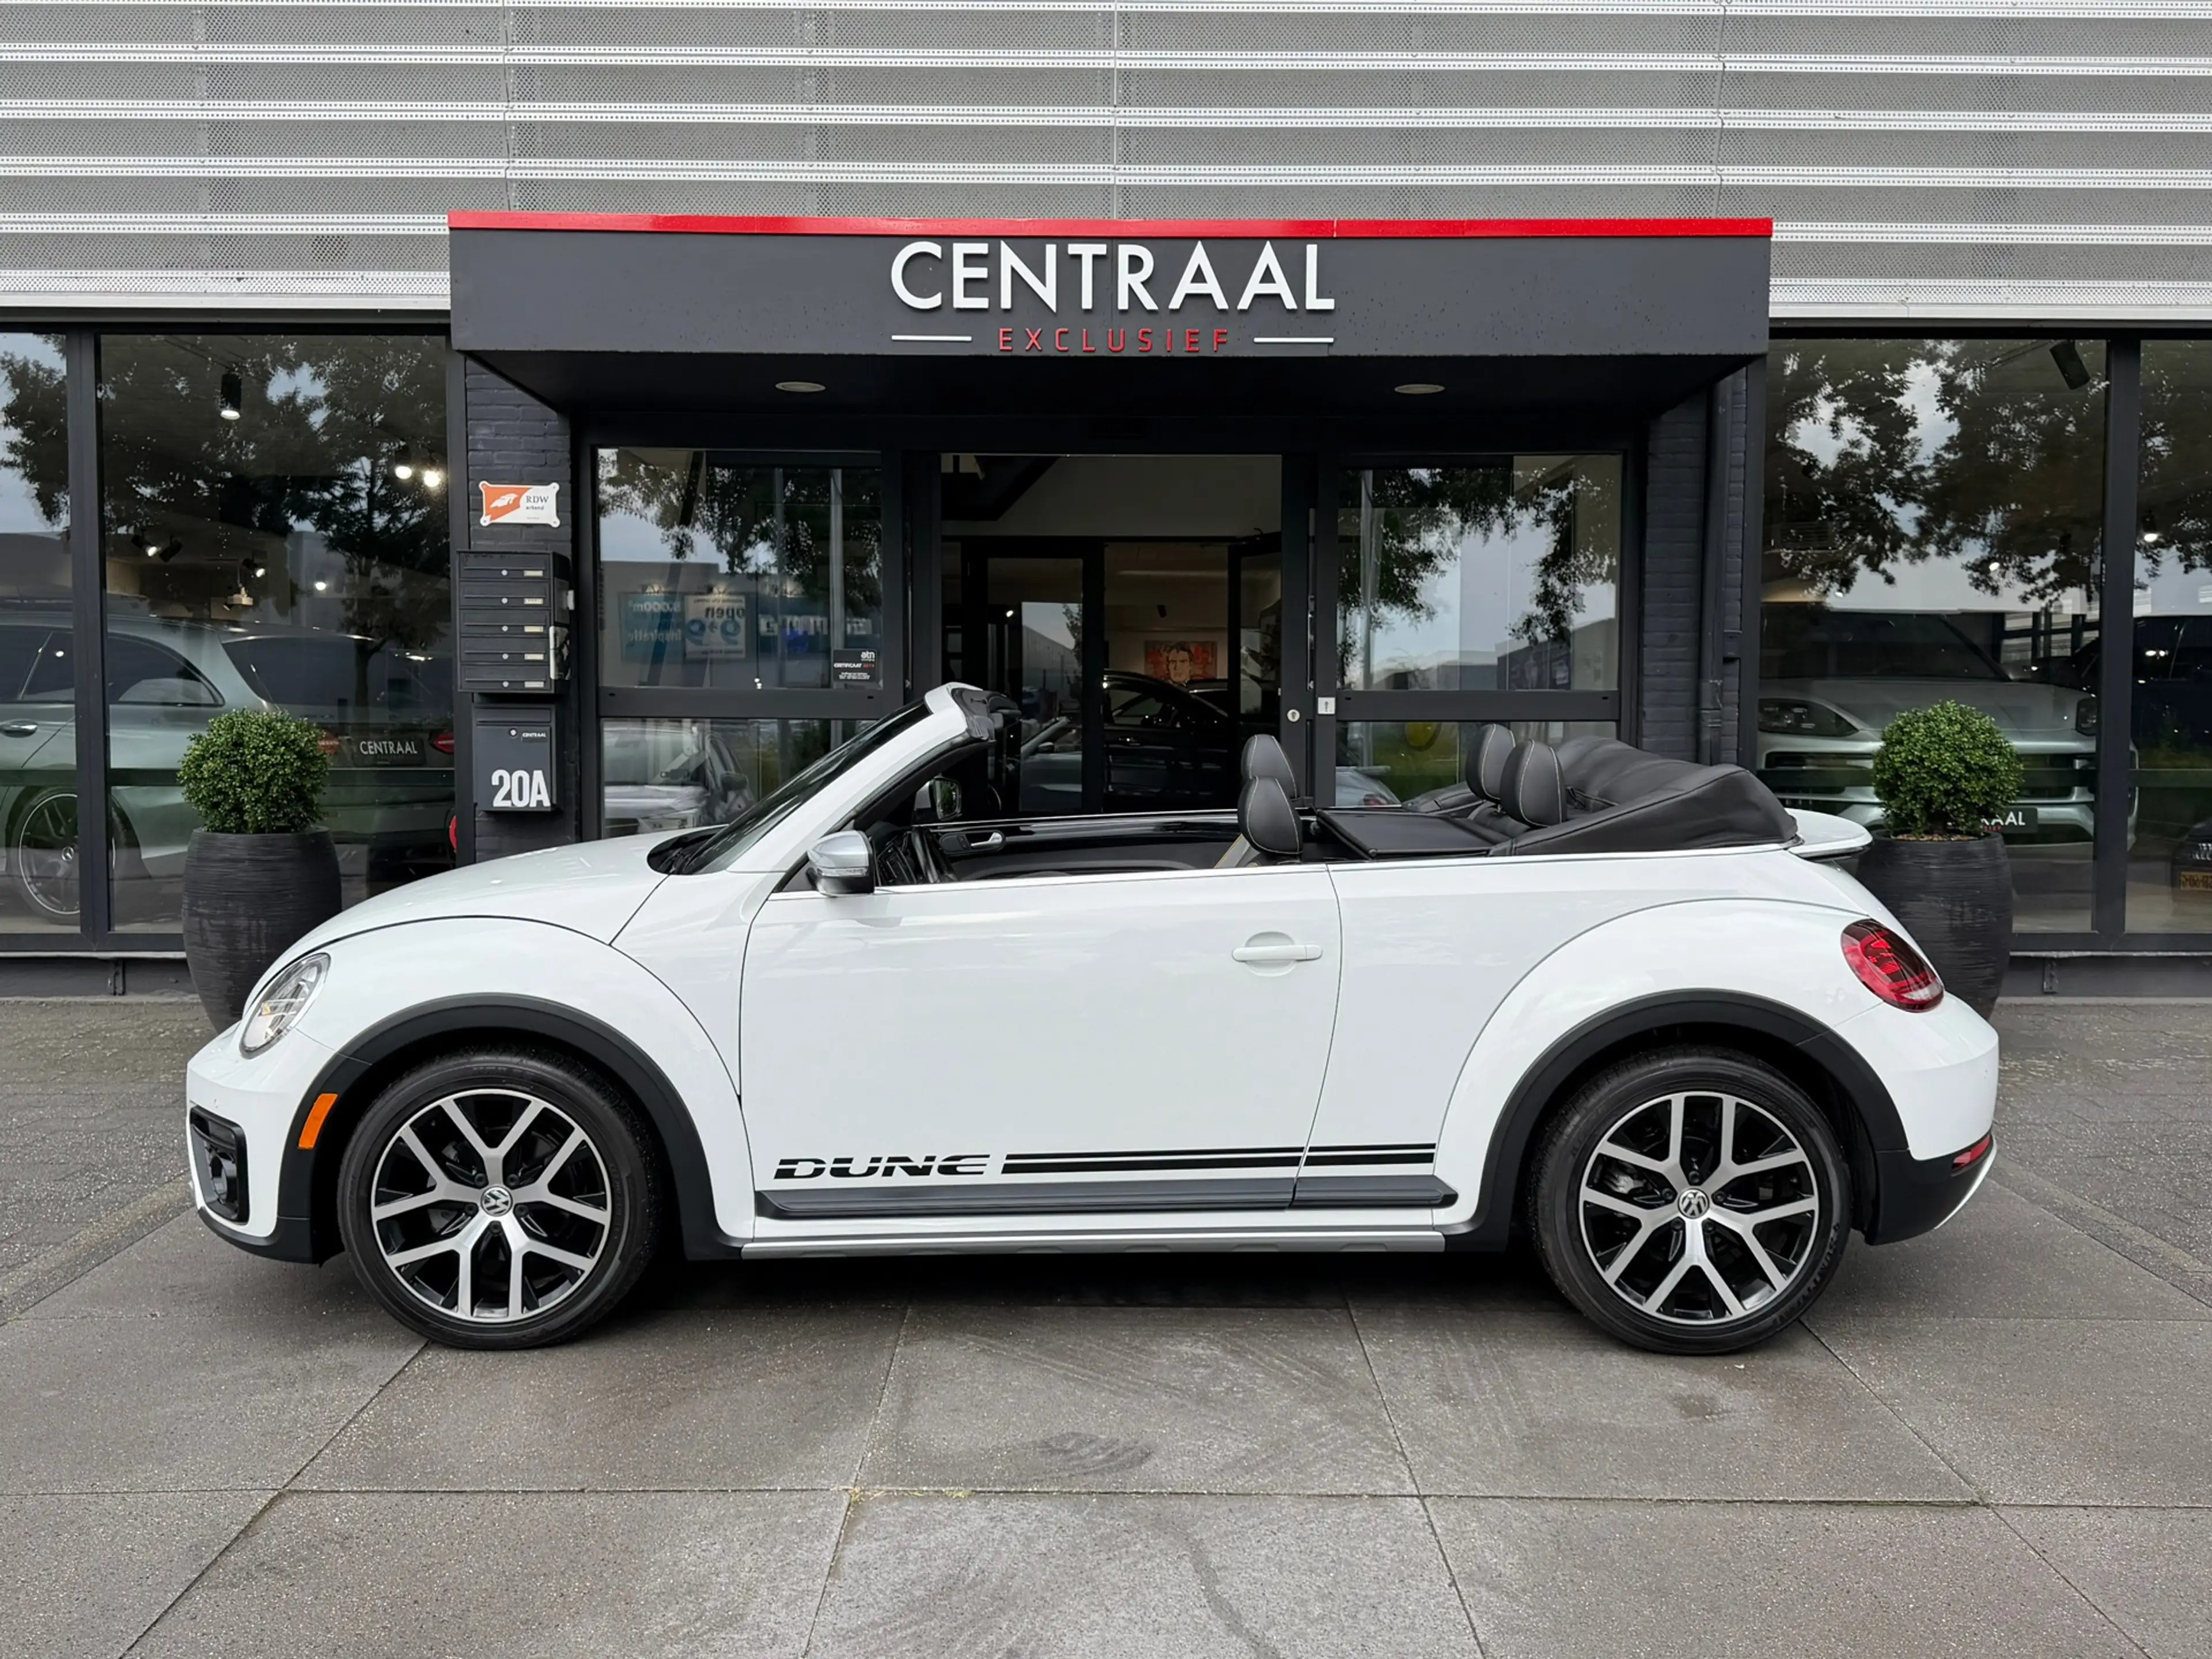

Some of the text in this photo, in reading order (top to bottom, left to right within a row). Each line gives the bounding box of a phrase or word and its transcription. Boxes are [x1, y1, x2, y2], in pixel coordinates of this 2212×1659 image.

[891, 240, 1335, 313] CENTRAAL
[998, 328, 1228, 352] EXCLUSIEF
[359, 741, 418, 755] CENTRAAL
[491, 769, 551, 808] 20A
[774, 1154, 990, 1179] DUNE
